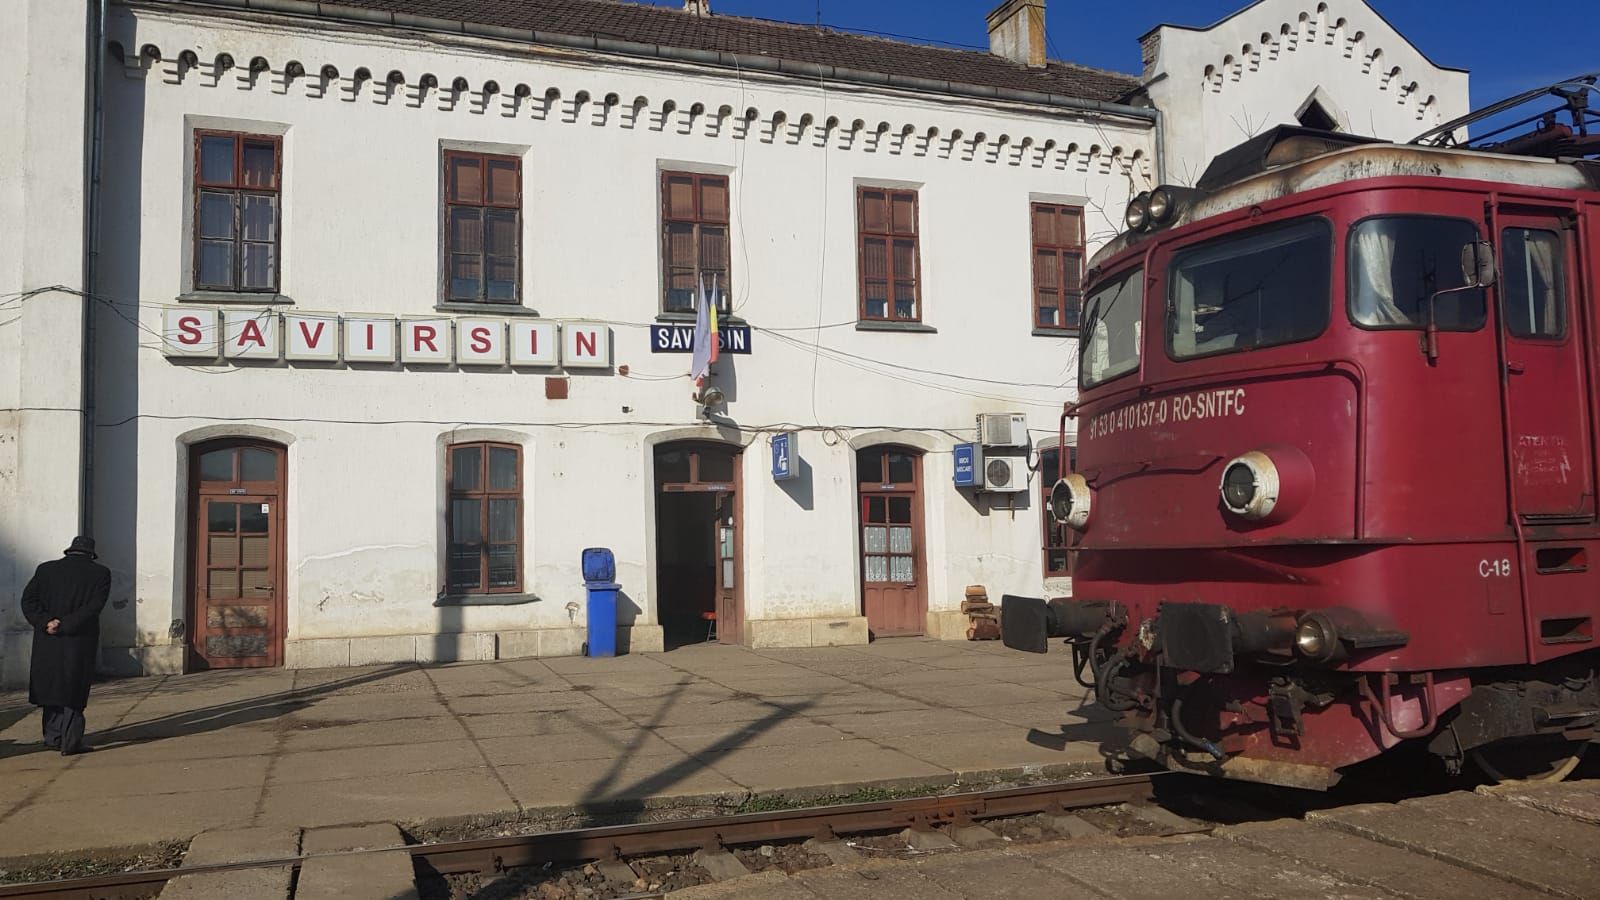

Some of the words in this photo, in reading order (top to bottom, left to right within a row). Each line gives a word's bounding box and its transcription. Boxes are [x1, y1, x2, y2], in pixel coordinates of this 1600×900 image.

[177, 316, 597, 357] SAVIRSIN
[1089, 417, 1097, 440] 91
[1099, 413, 1108, 437] 53
[1109, 411, 1116, 433] 0
[1117, 400, 1168, 431] 410137-0
[1173, 388, 1246, 422] RO-SNTFC
[1479, 559, 1510, 577] C-18
